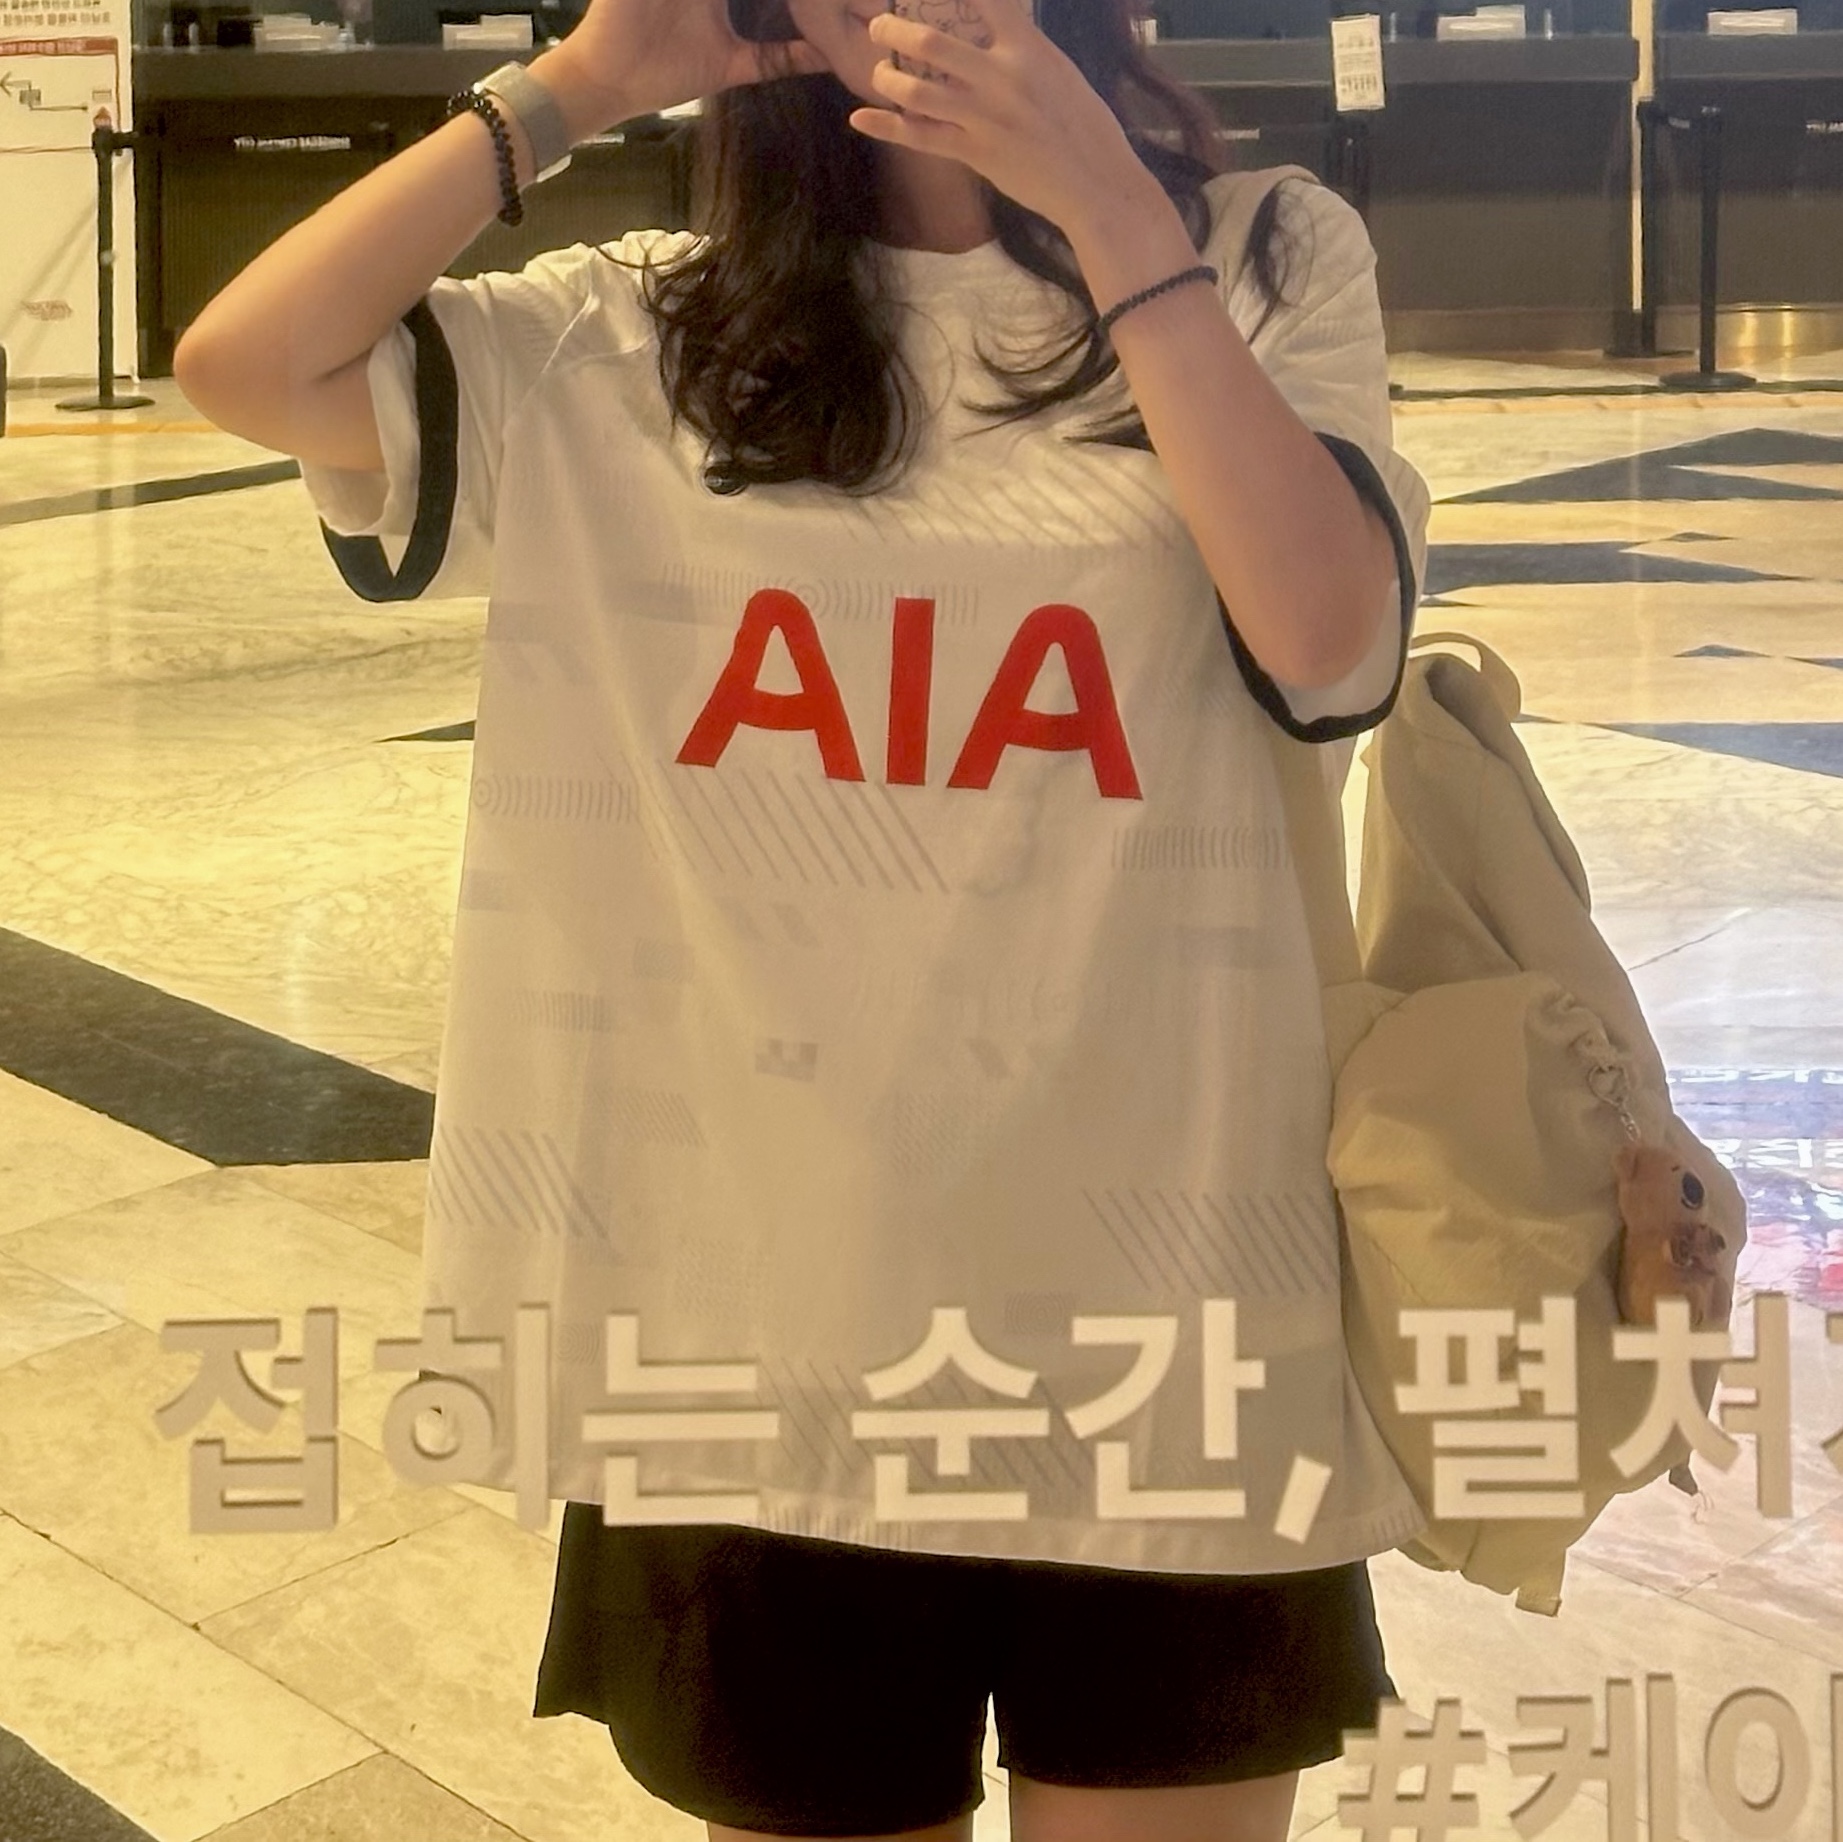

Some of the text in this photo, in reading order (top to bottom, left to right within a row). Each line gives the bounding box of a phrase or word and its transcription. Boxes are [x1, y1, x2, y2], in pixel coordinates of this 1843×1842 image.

[675, 588, 1143, 801] AIA
[154, 1291, 1843, 1543] 접히는 순간, 펼쳐
